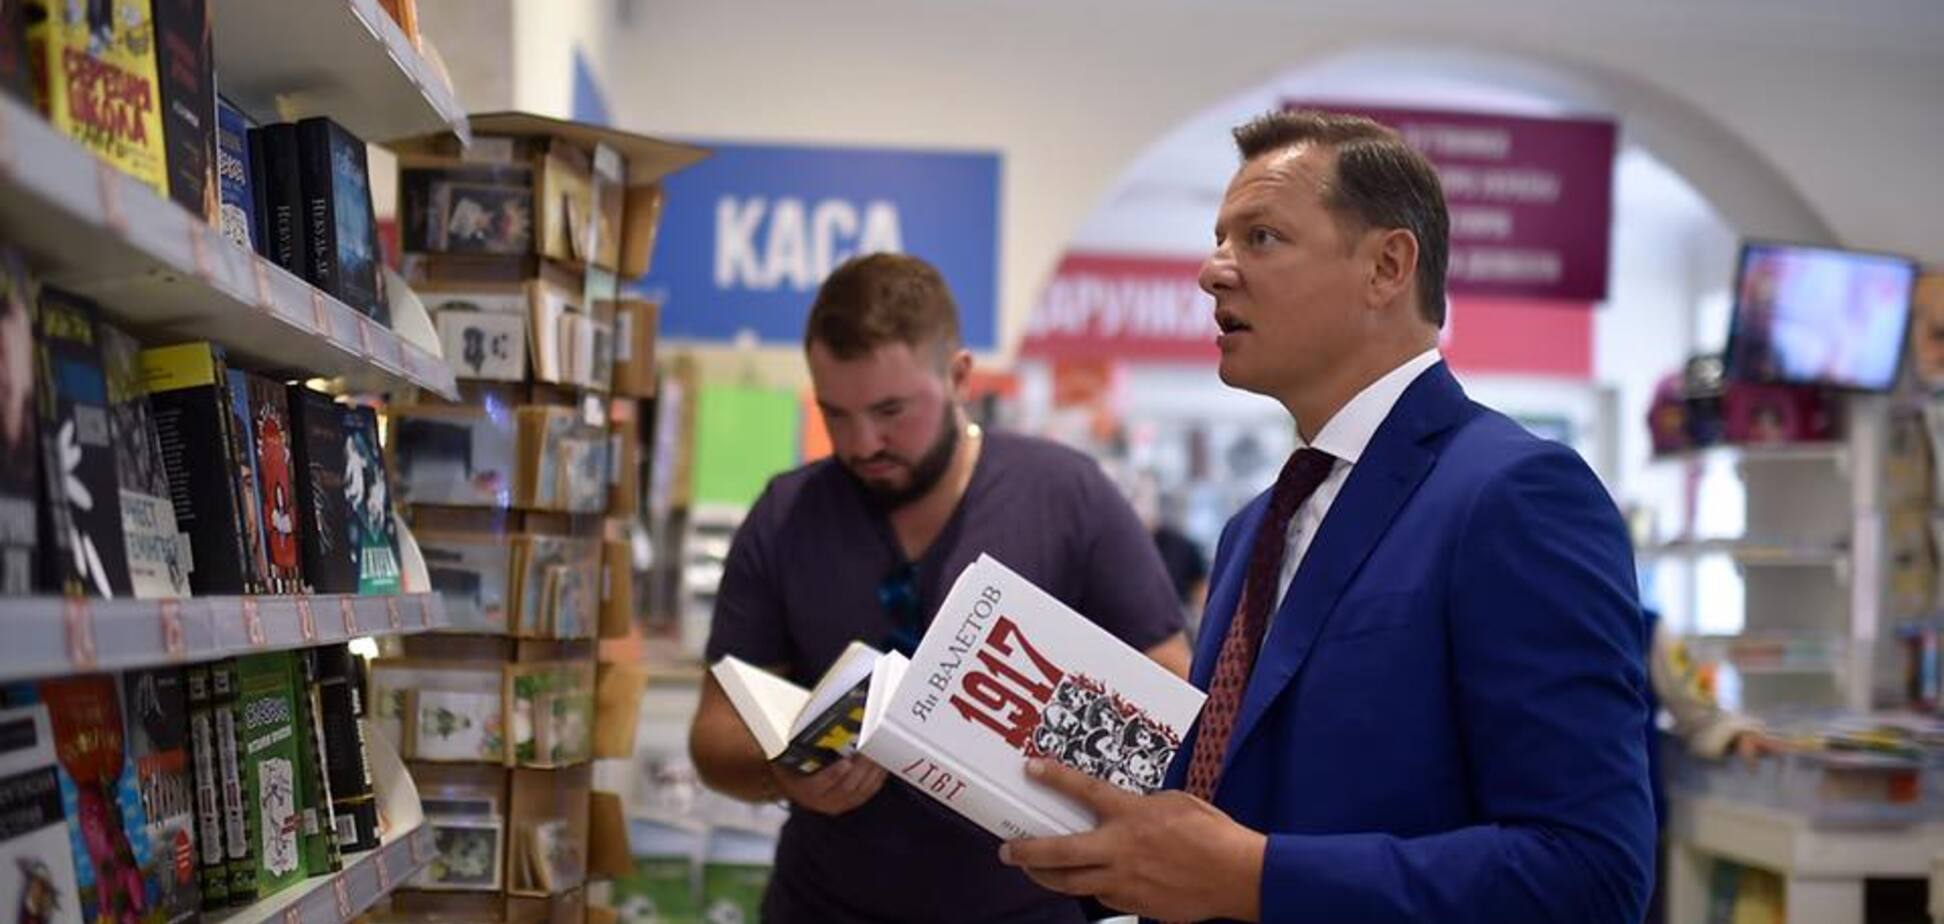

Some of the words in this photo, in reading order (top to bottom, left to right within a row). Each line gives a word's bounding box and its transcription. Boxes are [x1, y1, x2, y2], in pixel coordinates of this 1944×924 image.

[713, 194, 904, 289] КАСА
[912, 693, 938, 723] Ян
[929, 585, 1003, 690] ВАЛЕТОВ
[949, 615, 1064, 751] 1917
[902, 757, 967, 801] 1917
